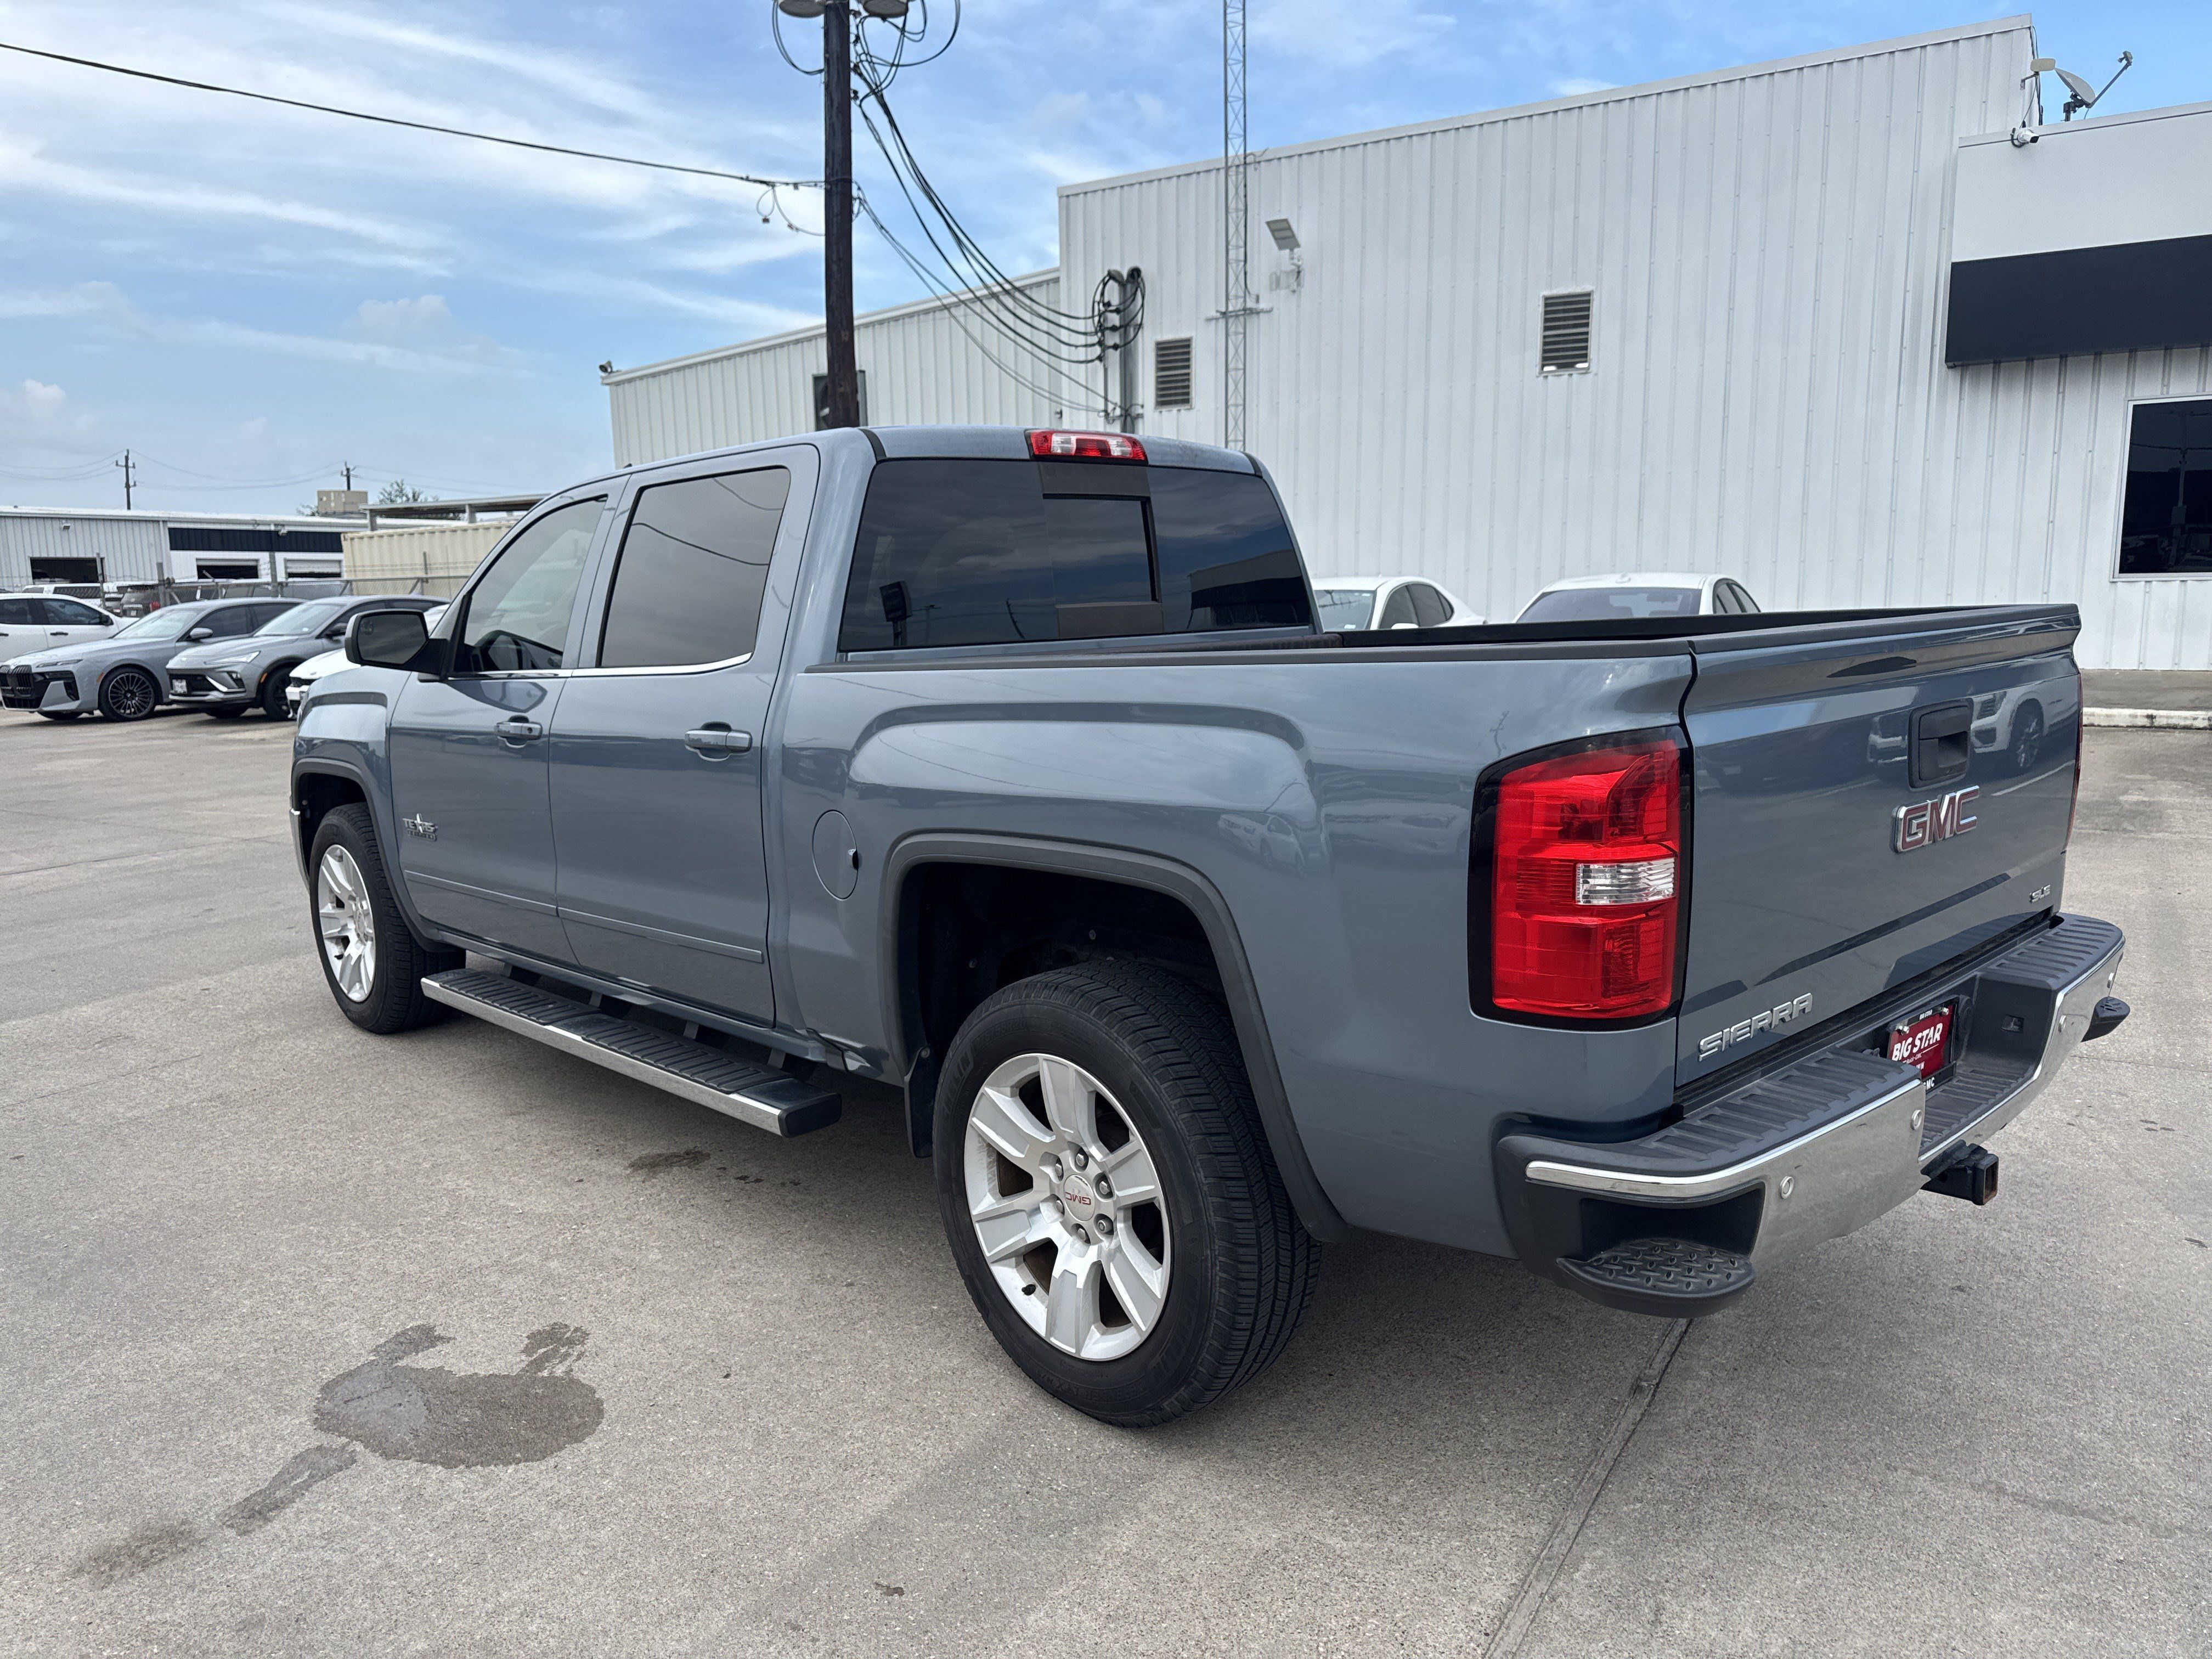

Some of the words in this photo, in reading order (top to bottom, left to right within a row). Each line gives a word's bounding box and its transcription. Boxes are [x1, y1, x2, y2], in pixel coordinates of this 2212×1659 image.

[1890, 785, 1979, 853] GMC
[1697, 992, 1813, 1062] SIERRA
[1892, 1037, 1912, 1061] BIG
[1912, 1023, 1943, 1053] STAR
[1065, 1192, 1092, 1206] GMC
